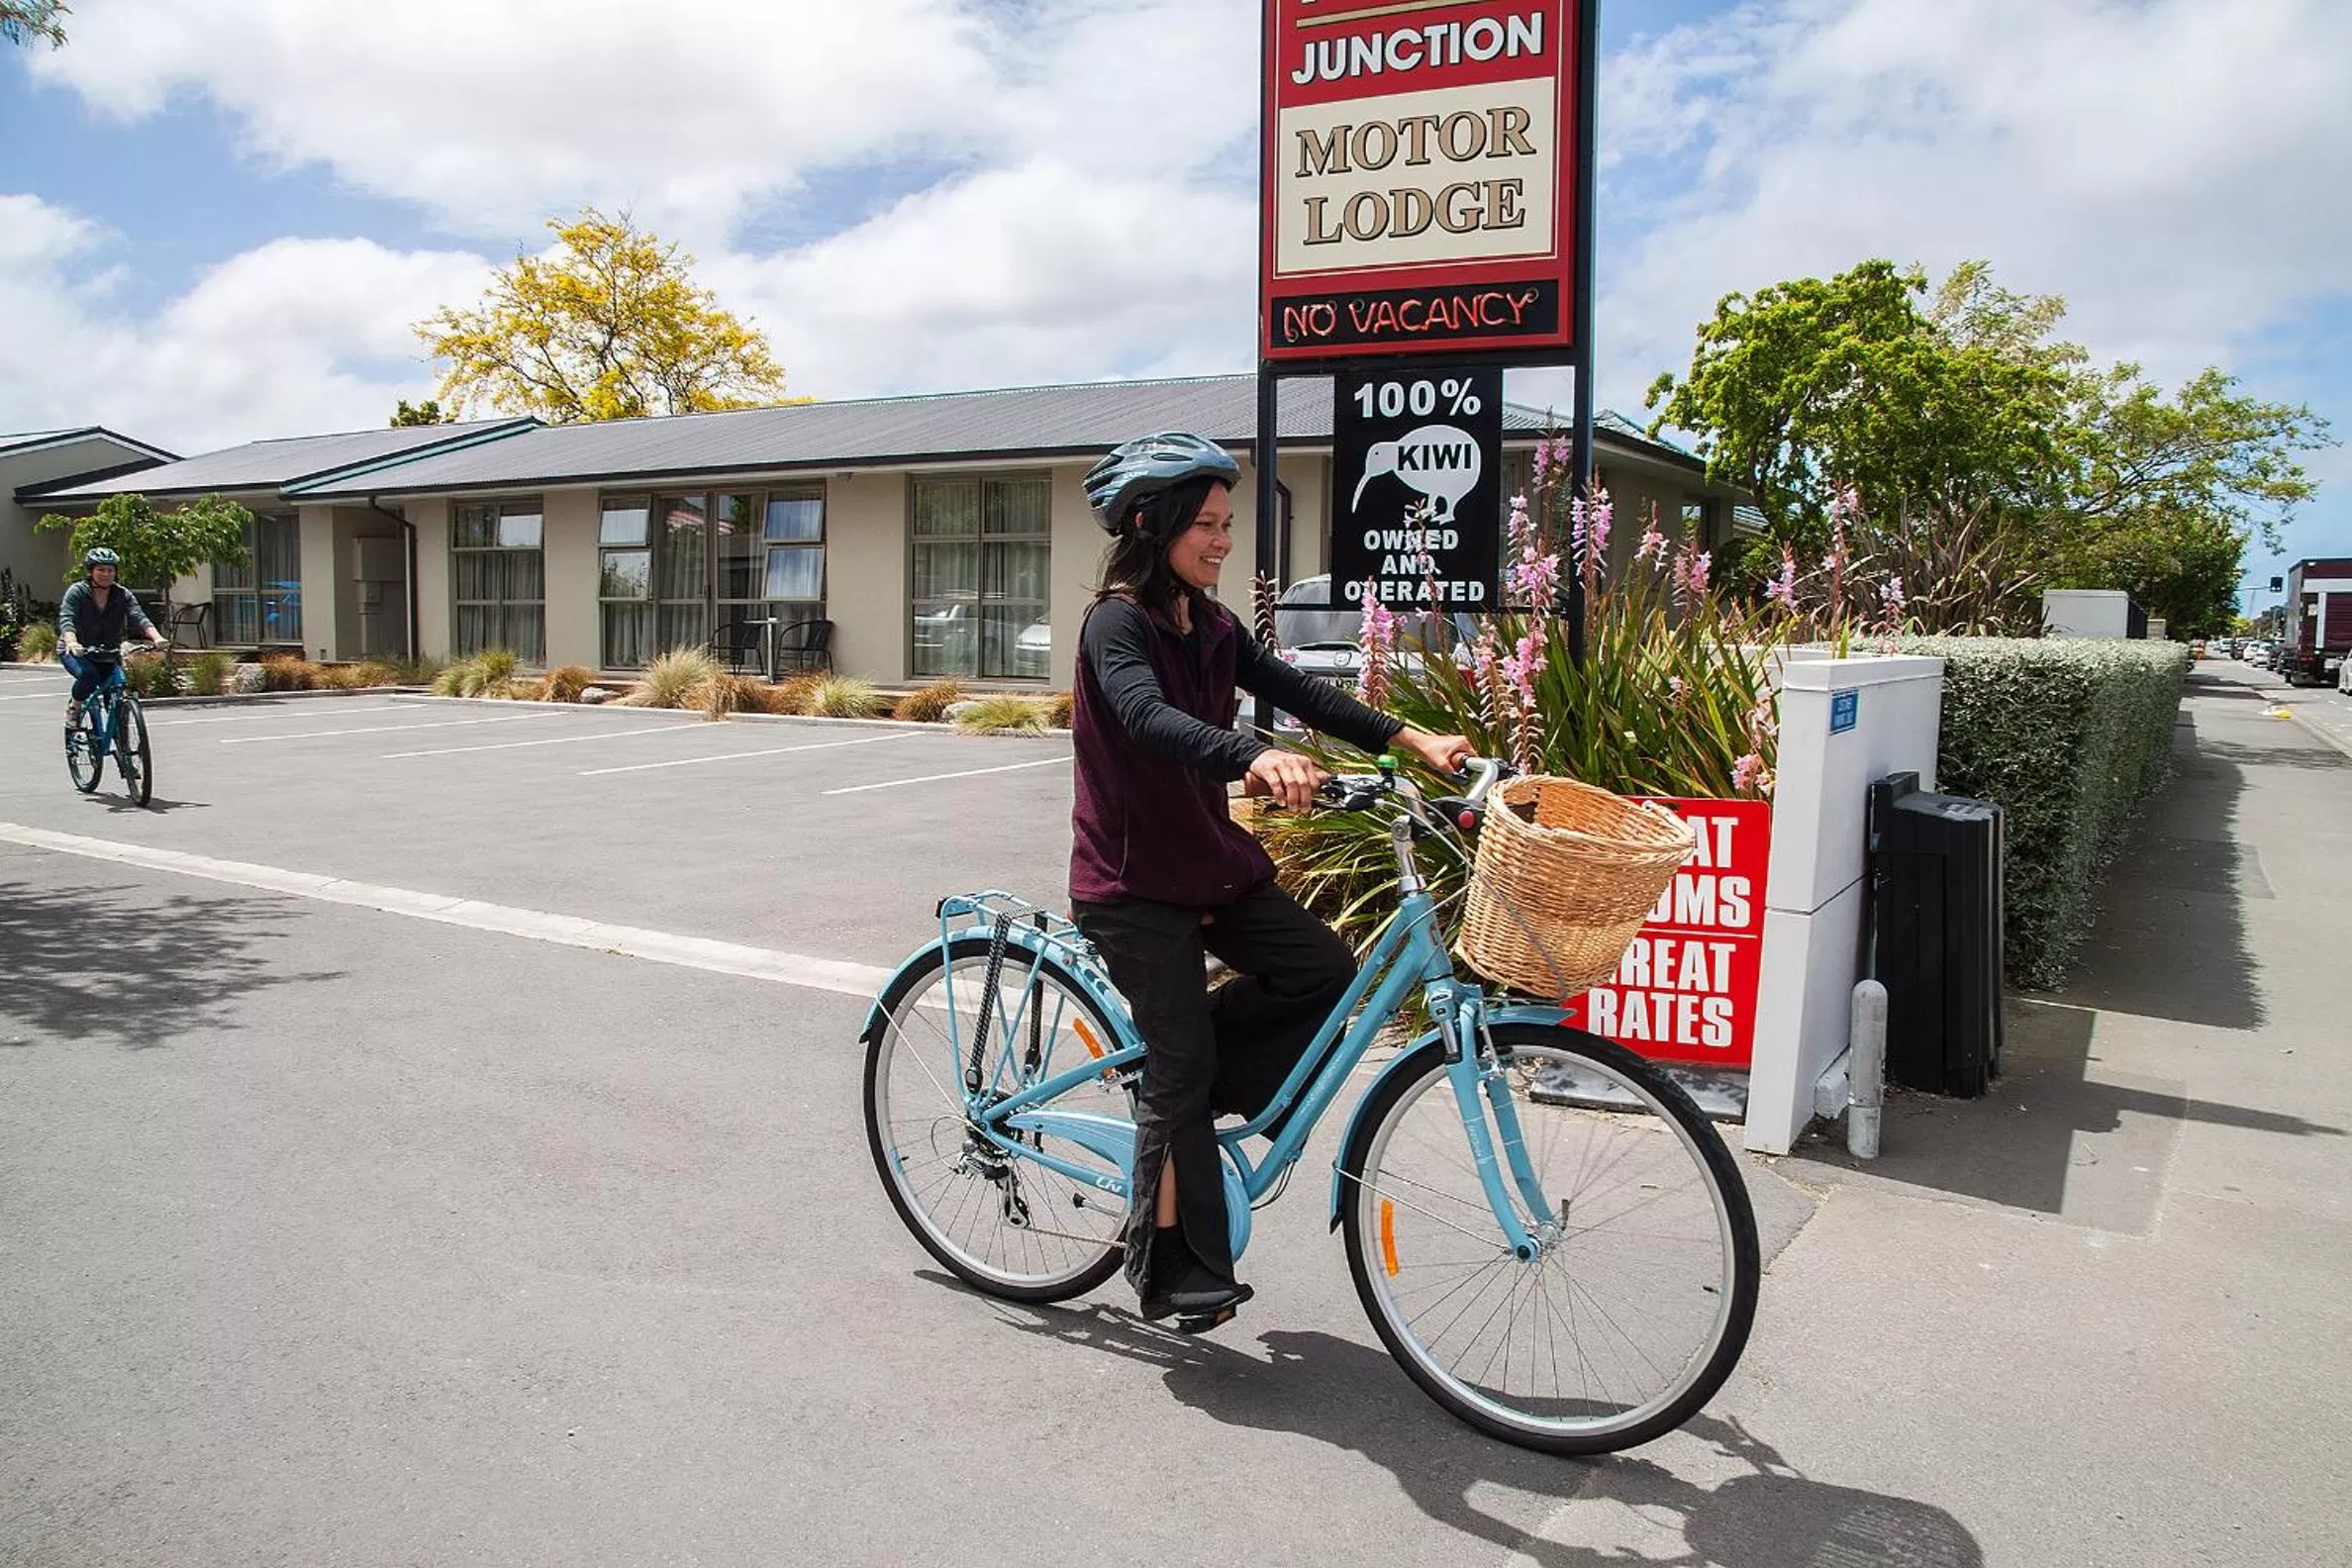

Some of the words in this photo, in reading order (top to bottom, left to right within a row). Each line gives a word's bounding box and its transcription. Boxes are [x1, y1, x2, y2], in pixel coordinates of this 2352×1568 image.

[1291, 12, 1544, 85] JUNCTION
[1295, 106, 1537, 178] MOTOR
[1303, 178, 1526, 246] LODGE
[1284, 303, 1336, 340] NO
[1348, 291, 1534, 334] VACANCY
[1354, 377, 1482, 418] 100%
[1397, 443, 1472, 471] KIWI
[1363, 529, 1459, 550] OWNED
[1610, 936, 1736, 994] REAT
[1587, 987, 1733, 1047] RATES
